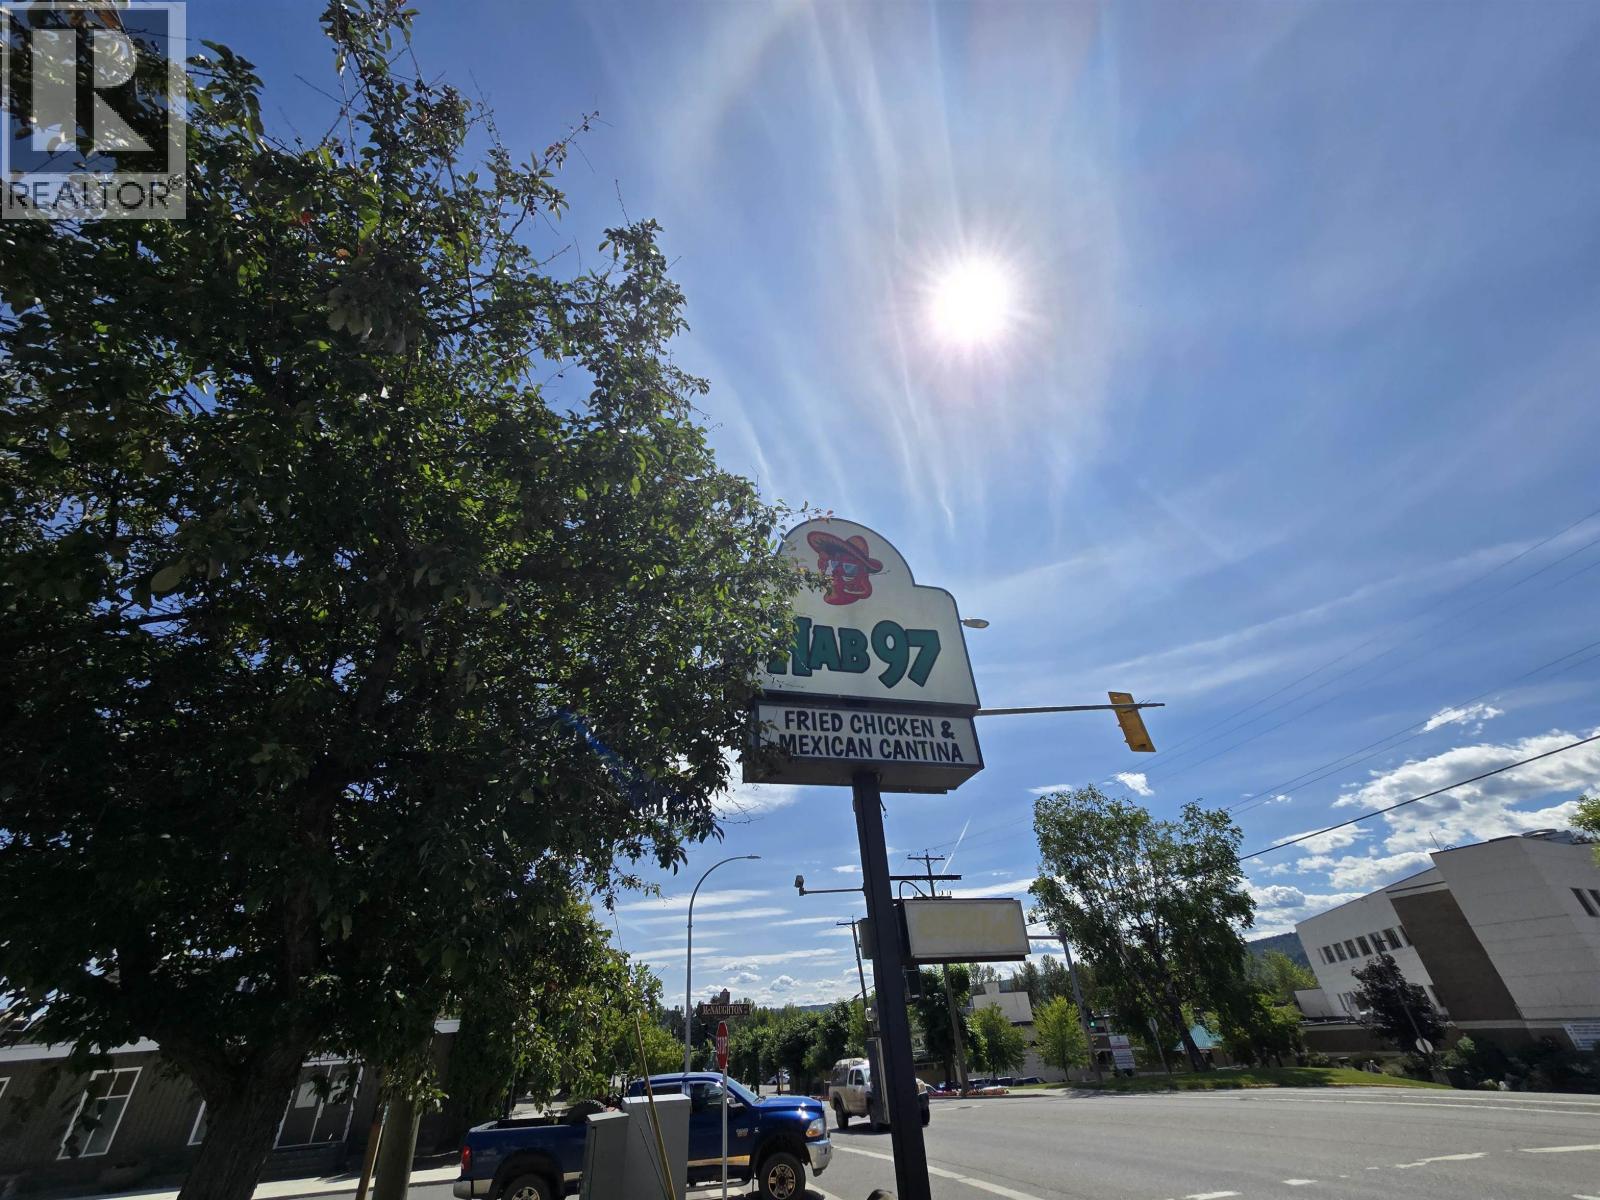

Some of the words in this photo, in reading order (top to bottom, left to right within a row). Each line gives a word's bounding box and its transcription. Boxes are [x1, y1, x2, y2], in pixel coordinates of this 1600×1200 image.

[784, 710, 843, 732] FRIED
[850, 714, 935, 738] CHICKEN
[941, 720, 955, 739] &
[779, 734, 873, 758] MEXICAN
[879, 739, 964, 762] CANTINA
